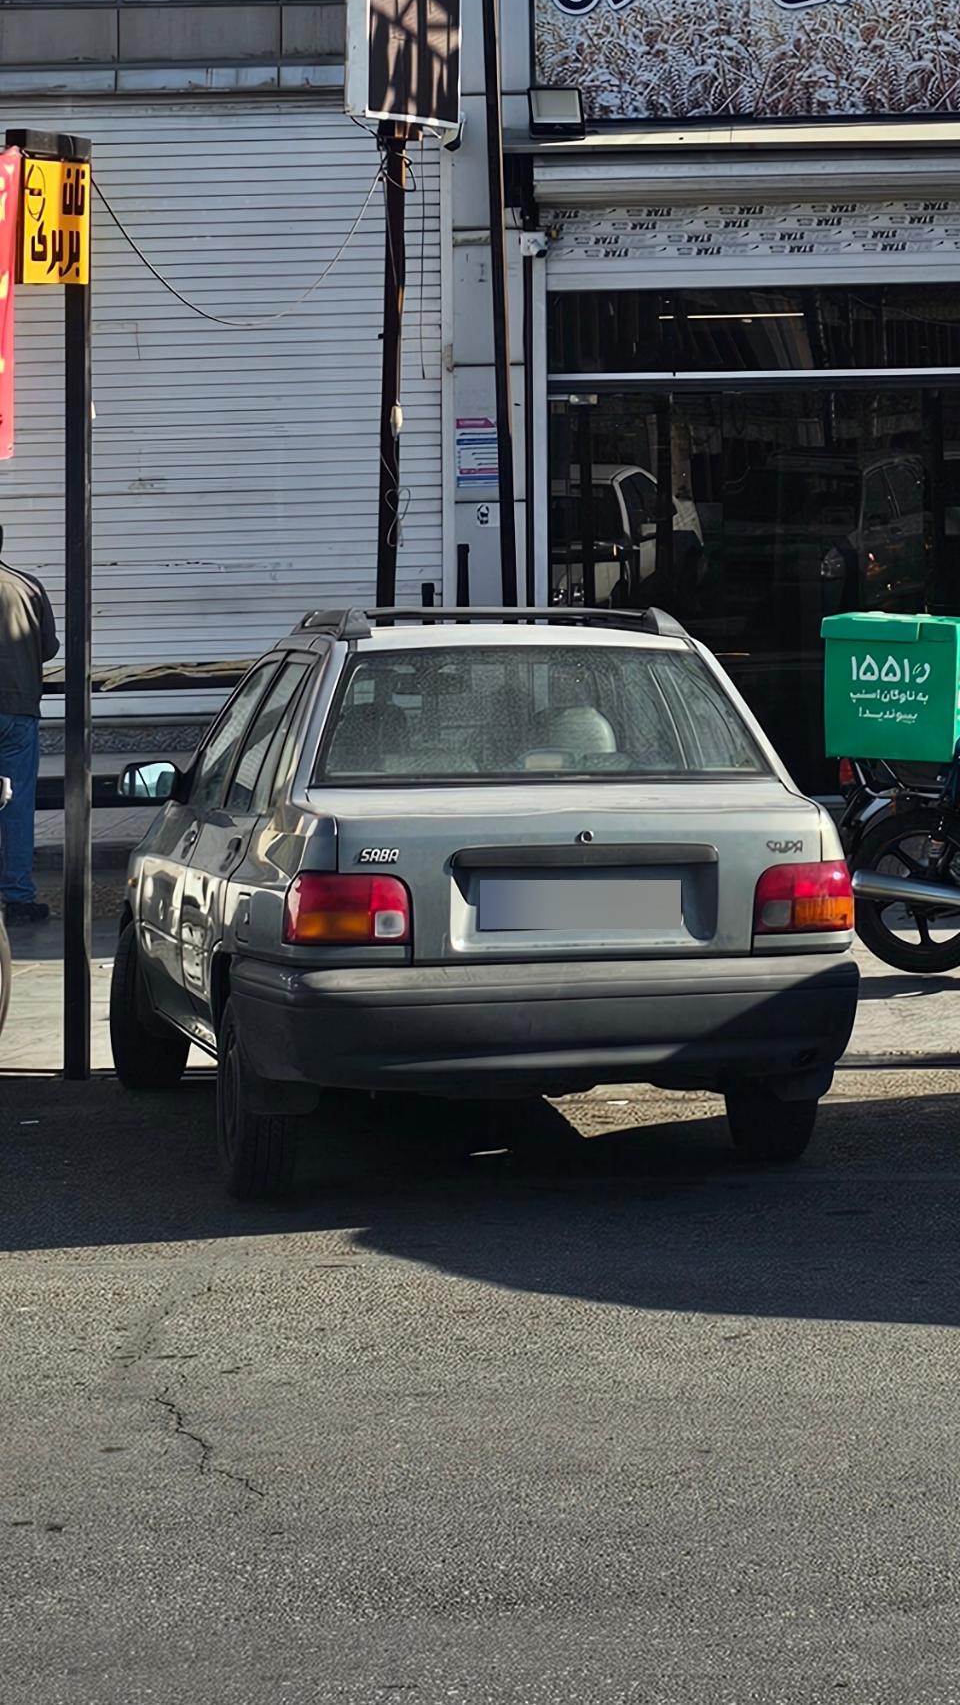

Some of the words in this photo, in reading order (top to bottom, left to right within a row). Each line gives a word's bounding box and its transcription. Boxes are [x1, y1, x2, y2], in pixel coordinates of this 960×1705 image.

[63, 167, 85, 216] نان
[738, 205, 764, 215] STAR
[830, 203, 857, 213] STAR
[923, 201, 949, 211] STAR
[553, 210, 580, 219] STAR
[646, 207, 672, 217] STAR
[723, 219, 749, 228] STAR
[816, 217, 842, 226] STAR
[908, 215, 935, 225] STAR
[630, 221, 657, 231] STAR
[686, 233, 713, 243] STAR
[779, 232, 805, 241] STAR
[871, 230, 897, 239] STAR
[593, 235, 620, 245] STAR
[696, 246, 722, 256] STAR
[789, 244, 815, 253] STAR
[881, 242, 907, 252] STAR
[603, 247, 629, 258] STAR
[360, 848, 400, 863] SABA
